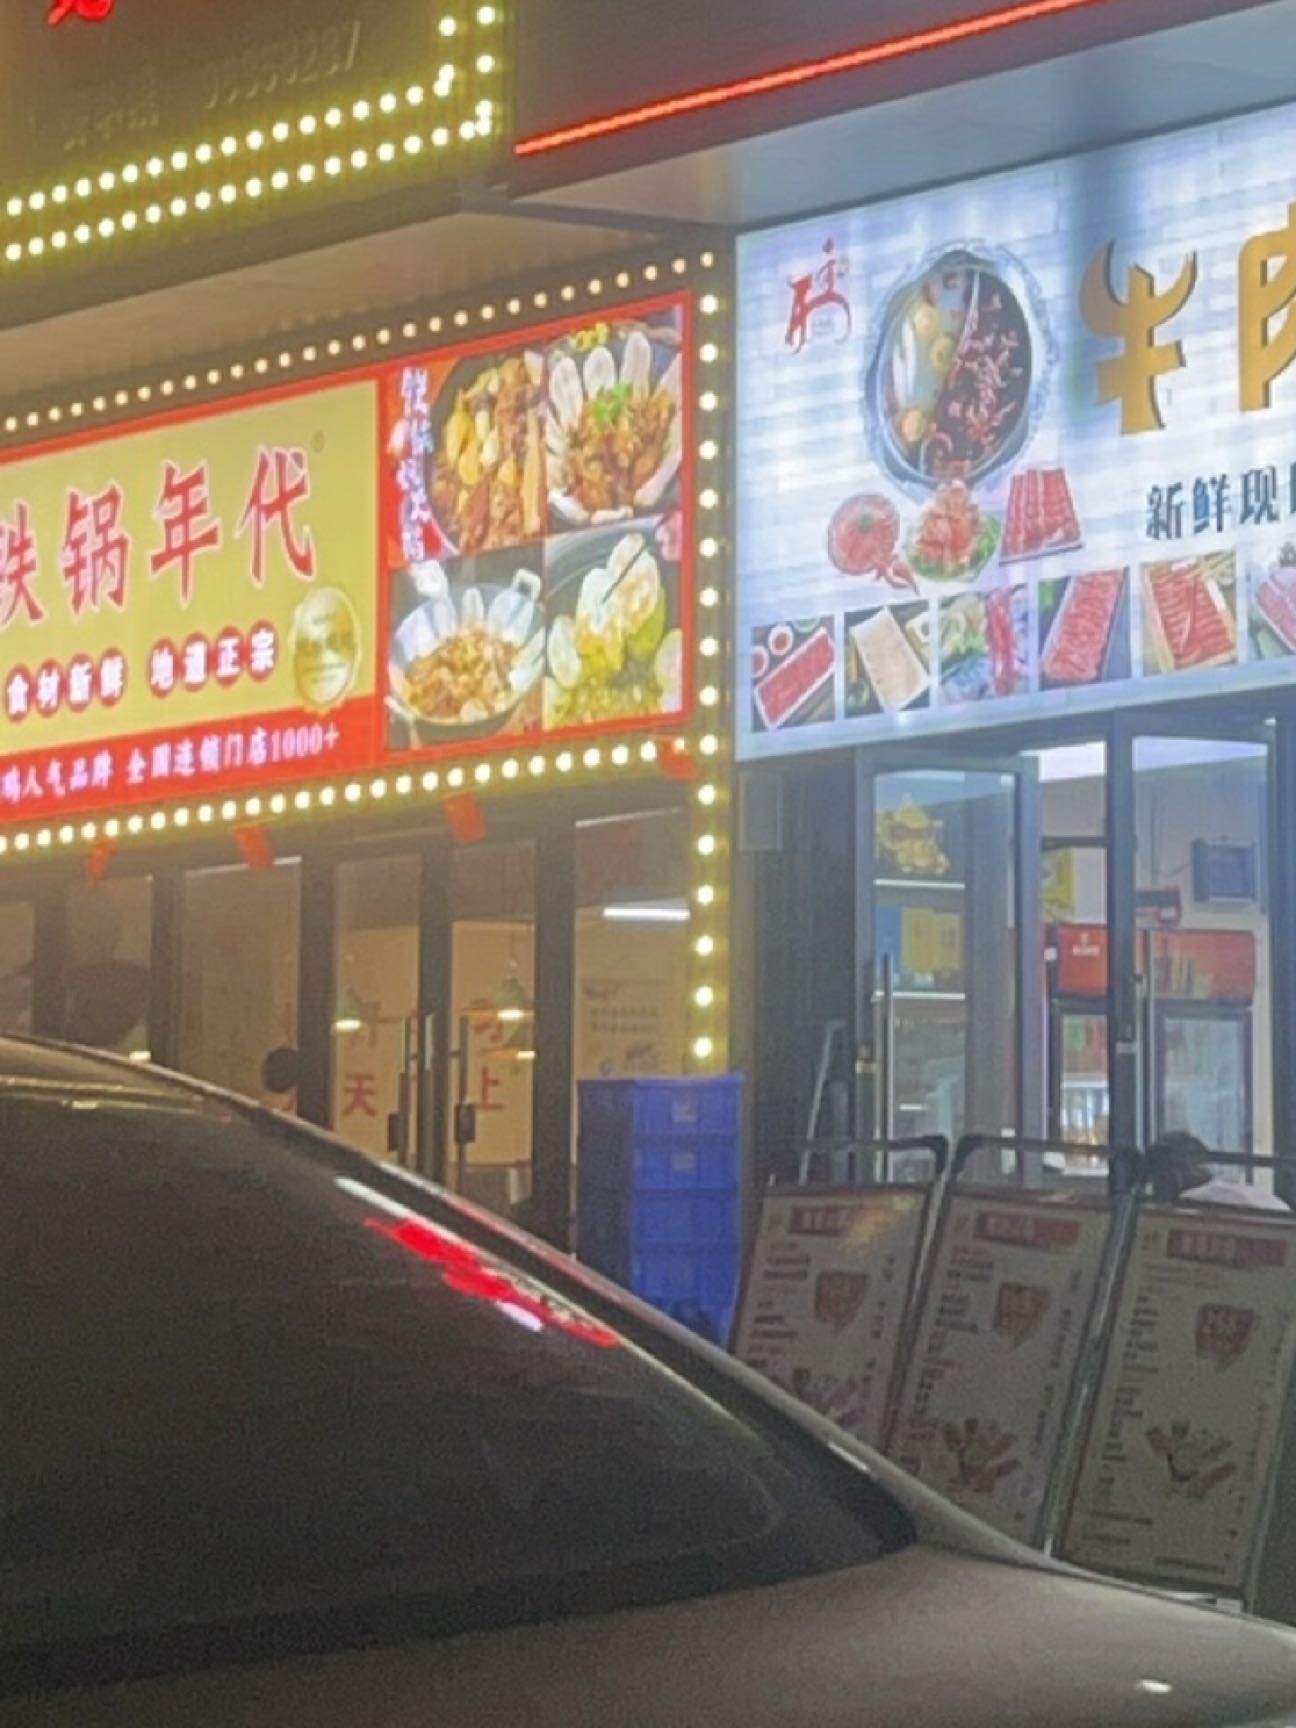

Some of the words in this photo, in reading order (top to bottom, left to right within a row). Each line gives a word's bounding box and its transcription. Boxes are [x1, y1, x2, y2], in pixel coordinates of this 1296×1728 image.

[0, 444, 315, 625] 铁锅年代
[6, 651, 125, 721] 食材新鲜
[150, 626, 276, 699] 地道正宗
